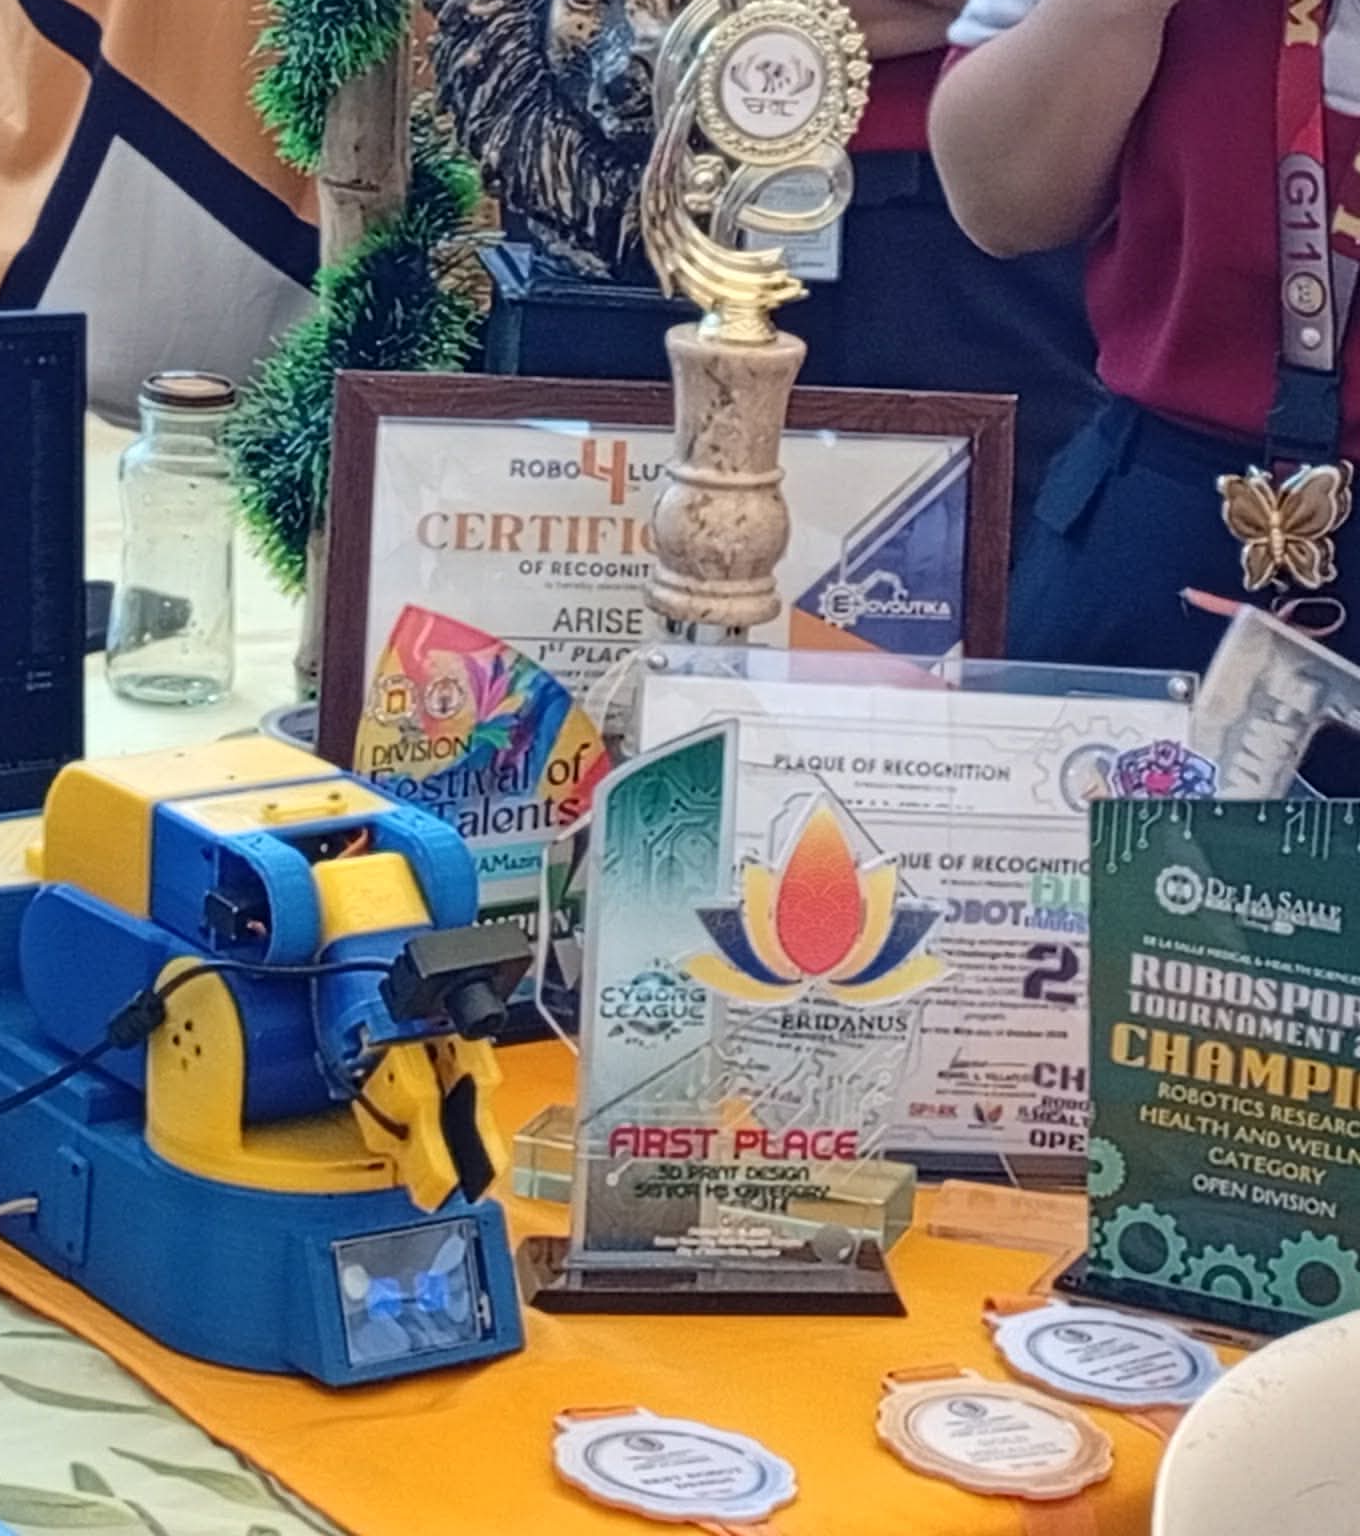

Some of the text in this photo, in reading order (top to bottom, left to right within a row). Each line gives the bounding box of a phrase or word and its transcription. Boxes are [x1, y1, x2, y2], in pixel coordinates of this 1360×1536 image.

[1283, 170, 1324, 262] G11
[518, 560, 544, 577] OF
[552, 607, 644, 636] ARISE
[371, 735, 473, 768] DIVISION
[546, 742, 592, 786] of
[774, 753, 1010, 782] PLAQUE OF RECOGNITION
[939, 852, 966, 870] OF
[601, 986, 706, 1003] CYBORG
[600, 1004, 705, 1020] LEAGUE
[780, 1014, 909, 1033] ERIDANUS
[1127, 988, 1345, 1055] TOURNAMENT
[1157, 1081, 1266, 1120] ROBOTICS
[609, 1127, 859, 1161] FIRST PLACE
[1139, 1104, 1230, 1142] HEALTH
[1233, 1125, 1283, 1151] AND
[745, 1165, 809, 1182] DESIGN
[1207, 1146, 1327, 1187] CATEGORY
[1192, 1173, 1337, 1220] OPEN DIVISION
